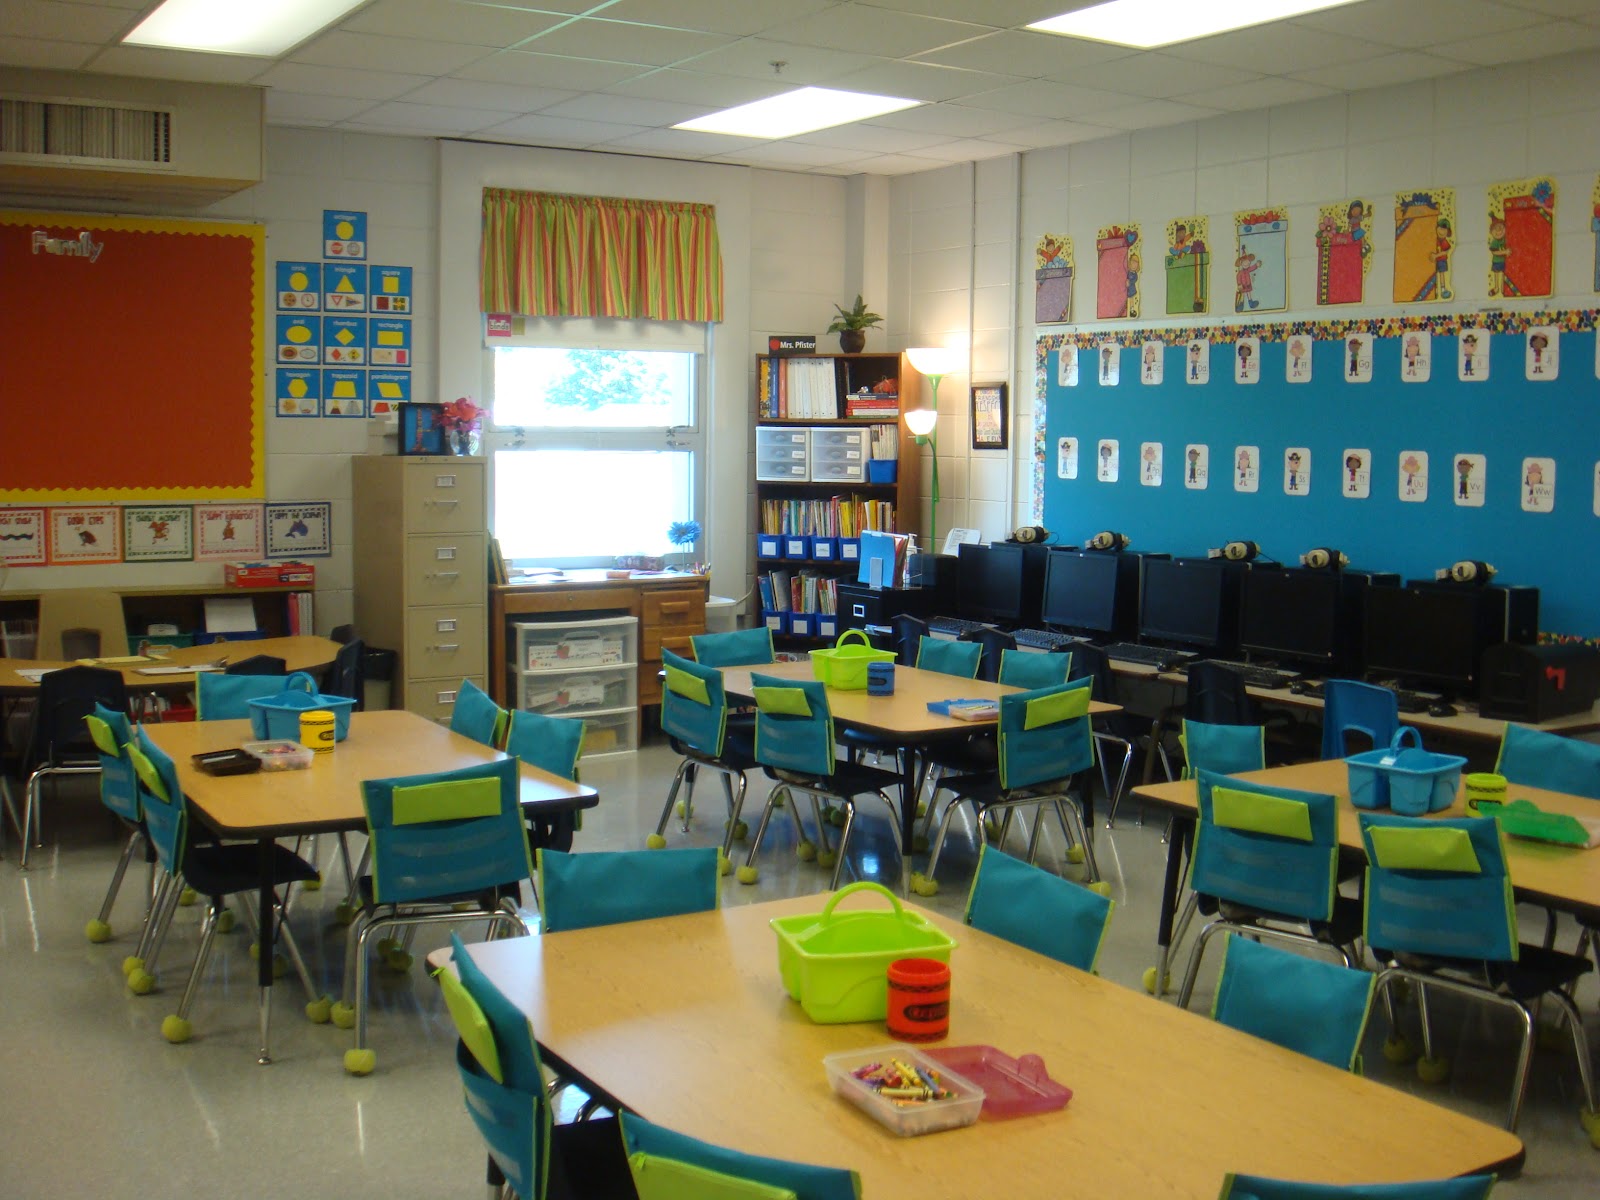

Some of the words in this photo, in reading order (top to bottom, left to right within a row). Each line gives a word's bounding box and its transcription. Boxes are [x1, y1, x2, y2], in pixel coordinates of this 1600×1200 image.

[31, 231, 104, 263] Family
[780, 341, 795, 349] Mrs.
[794, 341, 816, 349] Pfister
